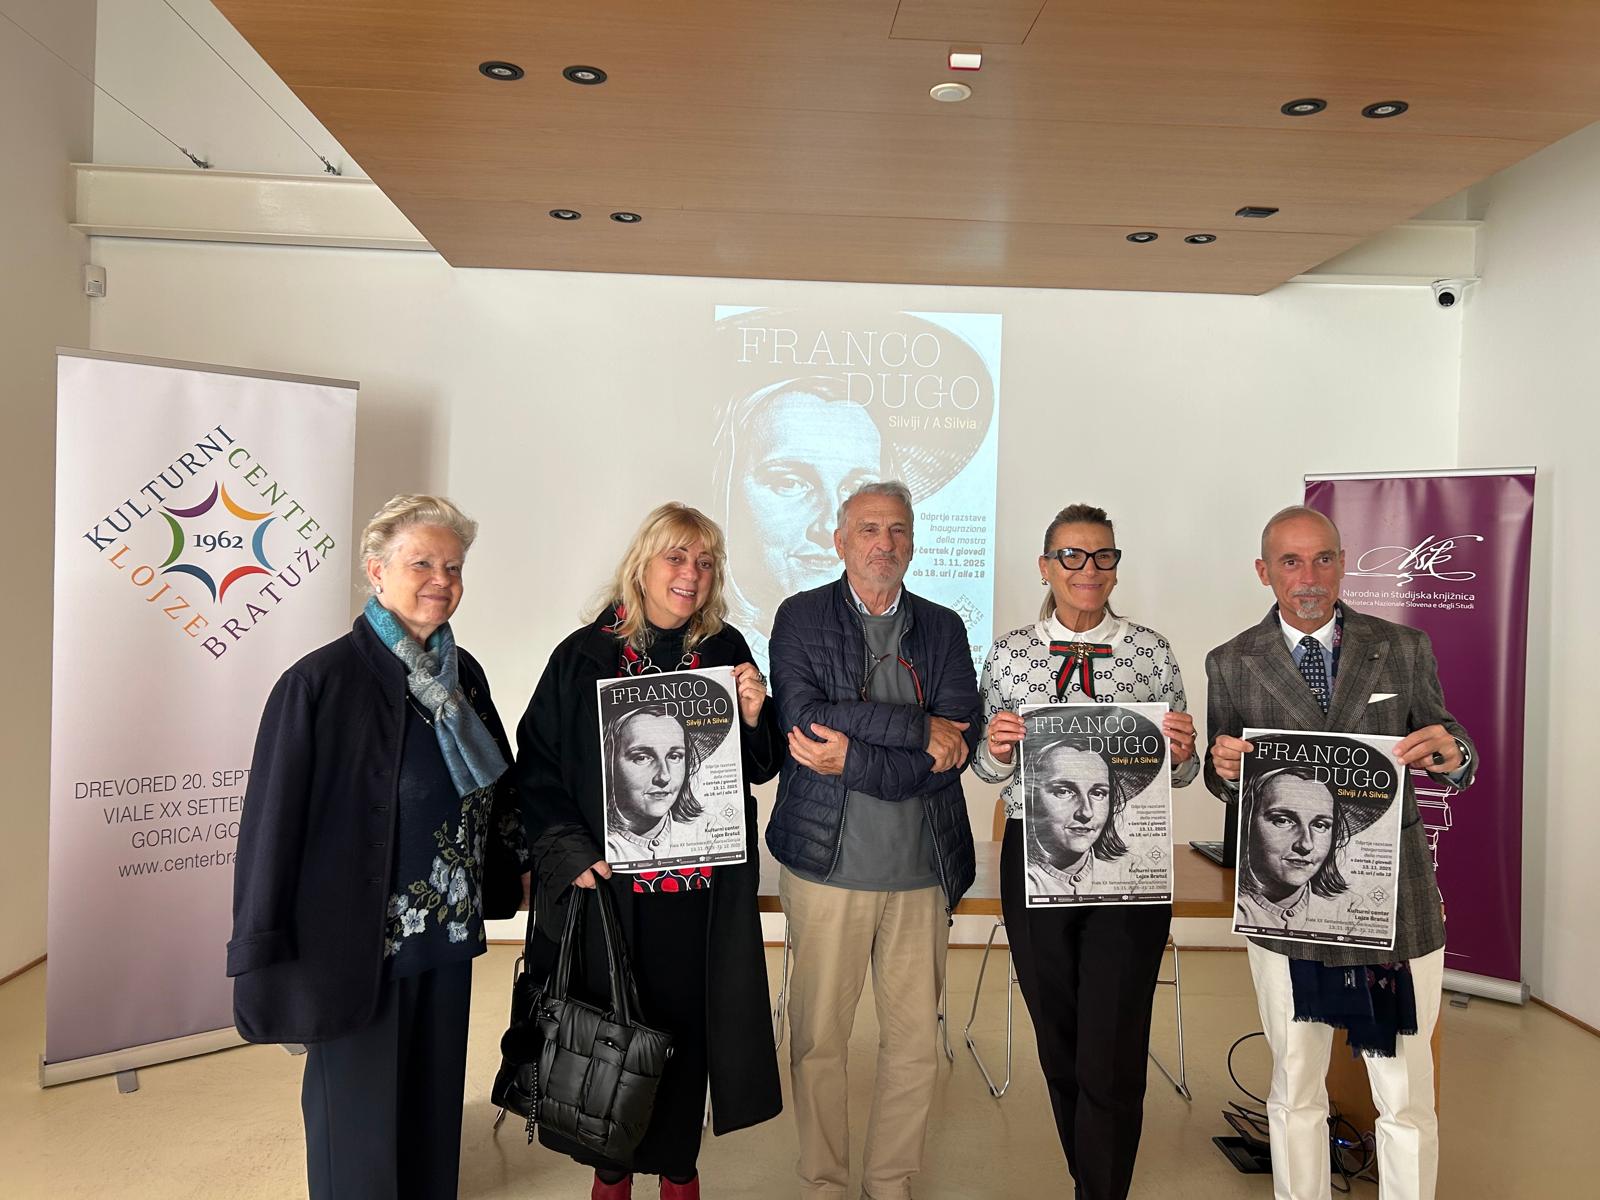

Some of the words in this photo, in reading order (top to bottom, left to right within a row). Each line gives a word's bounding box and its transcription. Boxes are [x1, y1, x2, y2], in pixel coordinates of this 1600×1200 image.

[737, 327, 941, 368] FRANCO
[845, 372, 980, 410] DUGO
[888, 415, 920, 430] Silviji
[932, 417, 941, 429] A
[943, 416, 977, 430] Silvia
[82, 424, 235, 552] KULTURNI
[228, 448, 335, 559] CENTER
[193, 530, 243, 552] 1962
[108, 544, 209, 638] LOJZE
[1342, 589, 1379, 599] Narodna
[1381, 590, 1390, 599] in
[1390, 589, 1432, 602] študijska
[1433, 591, 1475, 603] knjižnica
[200, 547, 320, 660] BRATUŽ
[1374, 600, 1405, 608] Nazionale
[1405, 601, 1432, 609] Slovena
[1438, 602, 1455, 610] degli
[1455, 602, 1475, 610] Studi
[611, 680, 708, 705] FRANCO
[662, 697, 728, 719] DUGO
[1032, 715, 1137, 734] FRANCO
[1086, 735, 1159, 755] DUGO
[1255, 741, 1369, 767] FRANCO
[1140, 756, 1158, 764] Silvia
[75, 775, 176, 799] DREVORED
[182, 773, 206, 790] 20.
[1311, 766, 1391, 790] DUGO
[1368, 790, 1389, 799] Silvia
[103, 804, 154, 825] VIALE
[159, 801, 182, 819] XX
